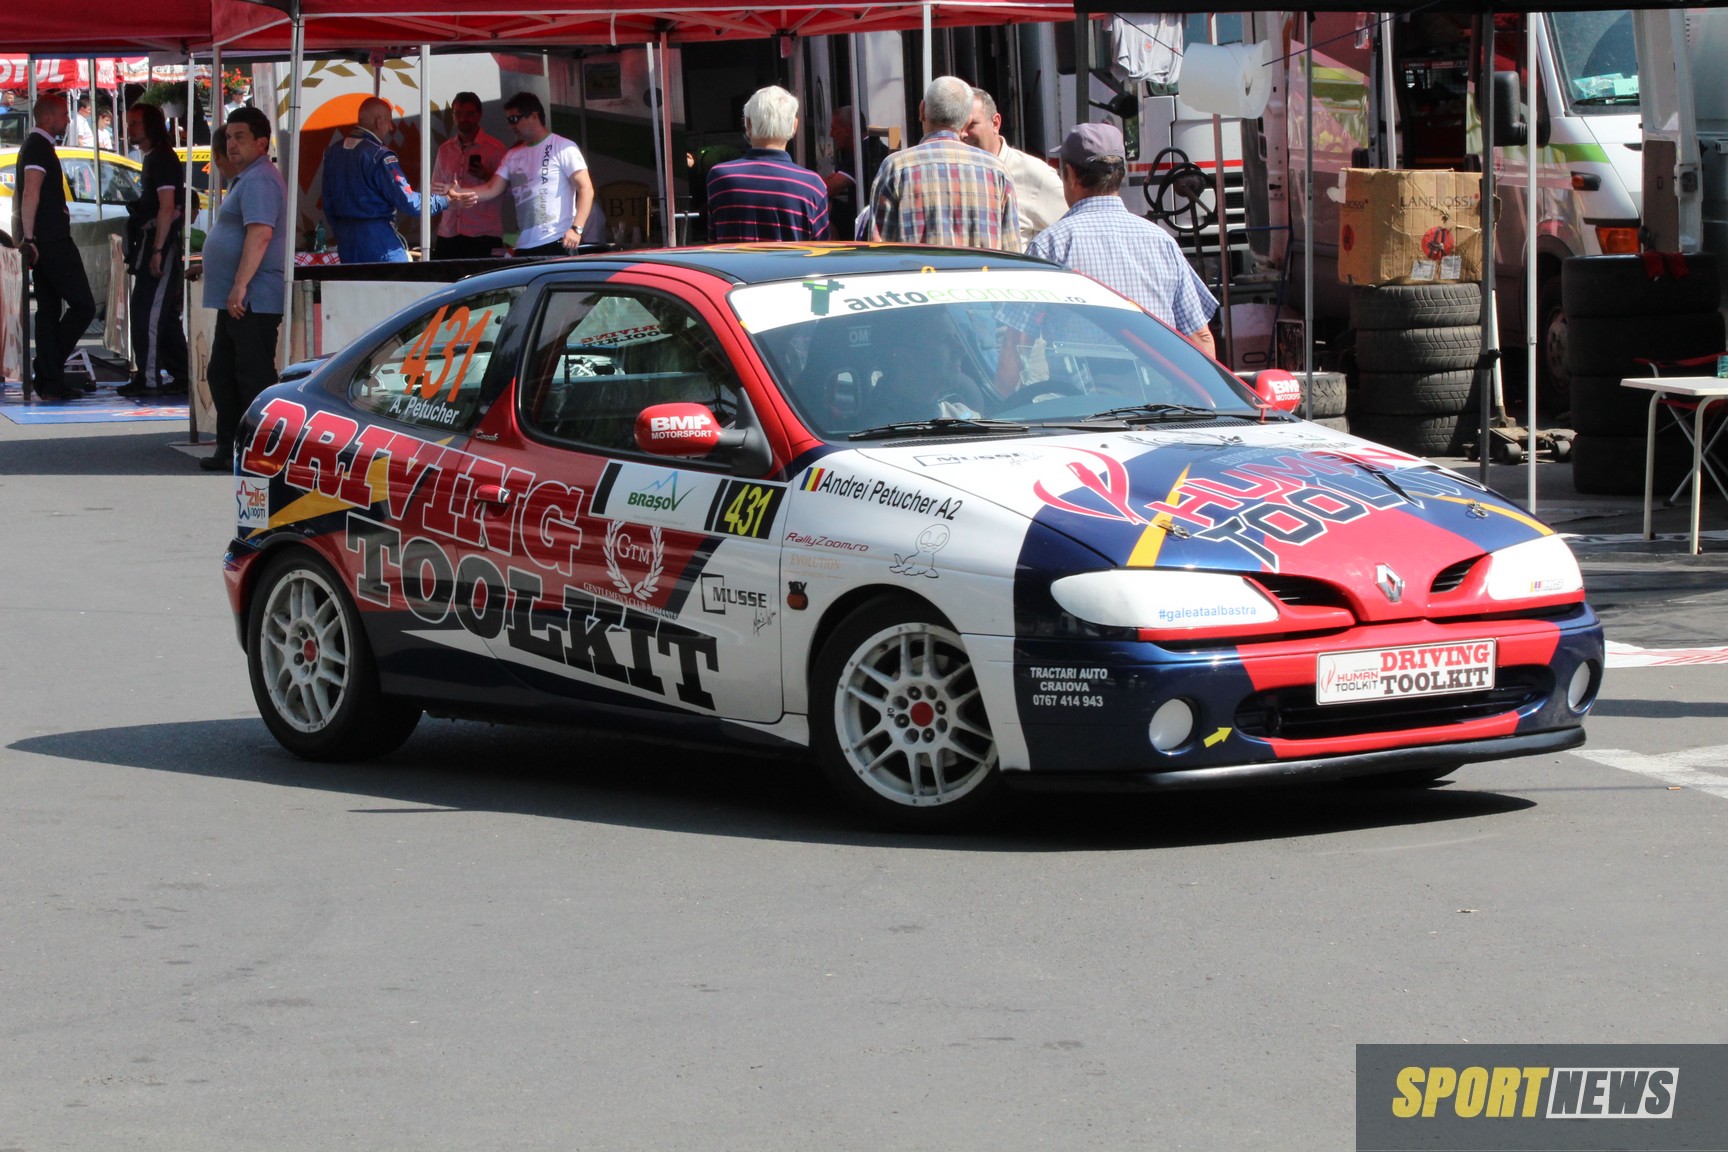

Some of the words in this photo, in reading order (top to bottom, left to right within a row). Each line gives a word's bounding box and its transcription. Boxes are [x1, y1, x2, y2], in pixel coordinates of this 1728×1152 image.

[400, 304, 493, 402] 431
[389, 399, 402, 414] A.
[406, 396, 460, 425] Petucher
[650, 414, 711, 432] BMP
[651, 430, 713, 440] MOTORSPORT
[241, 397, 584, 576] DRIVING
[818, 470, 872, 500] Andrei
[868, 480, 937, 515] Petucher
[934, 497, 963, 521] A2
[723, 483, 775, 538] 431
[785, 532, 869, 552] RallyZoom.ro
[713, 586, 767, 609] MUSSE
[346, 511, 720, 712] TOOLKIT
[1158, 605, 1257, 623] #galeataalbastra
[1380, 643, 1490, 672] DRIVING
[1030, 667, 1076, 679] TRACTARI
[1079, 667, 1108, 680] AUTO
[1337, 670, 1378, 682] HUMAN
[1380, 667, 1489, 695] TOOLKIT
[1040, 681, 1090, 692] CRAIOVA
[1335, 680, 1378, 692] TOOLKIT
[1033, 694, 1057, 706] 0767
[1060, 695, 1080, 707] 414
[1082, 695, 1104, 708] 943
